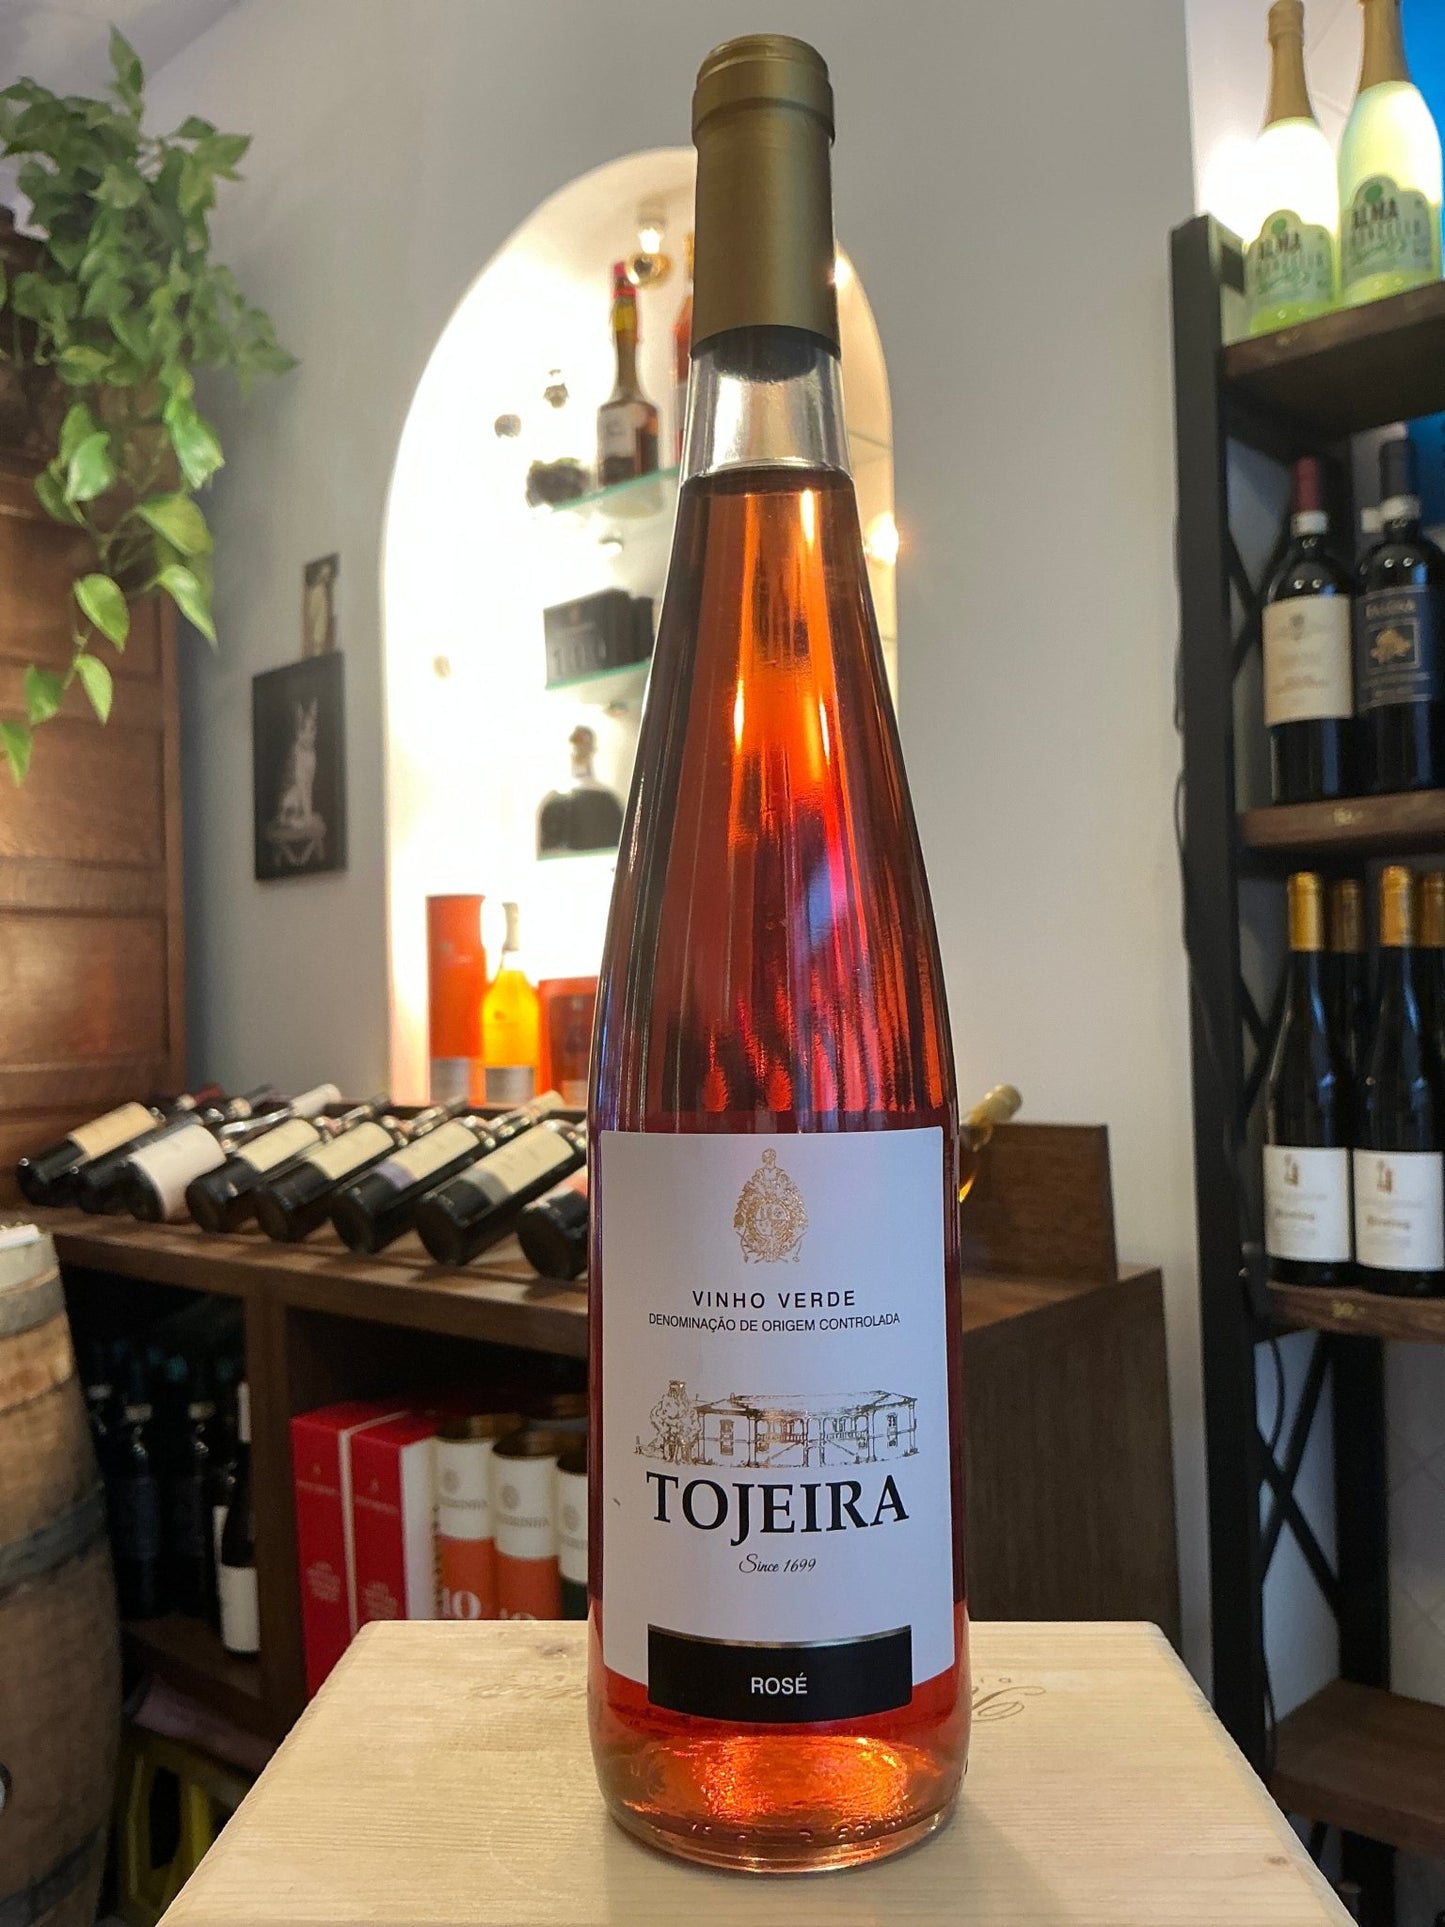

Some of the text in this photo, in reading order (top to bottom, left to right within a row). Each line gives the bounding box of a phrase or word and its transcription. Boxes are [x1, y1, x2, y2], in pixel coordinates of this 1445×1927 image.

[692, 1290, 856, 1309] VINHO VERDE
[649, 1312, 901, 1333] DENOMINAÇÃO DE ORIGEM CONTROLADA
[646, 1470, 910, 1547] TOJEIRA
[738, 1553, 817, 1574] Since 1699
[751, 1672, 808, 1695] ROSÉ
